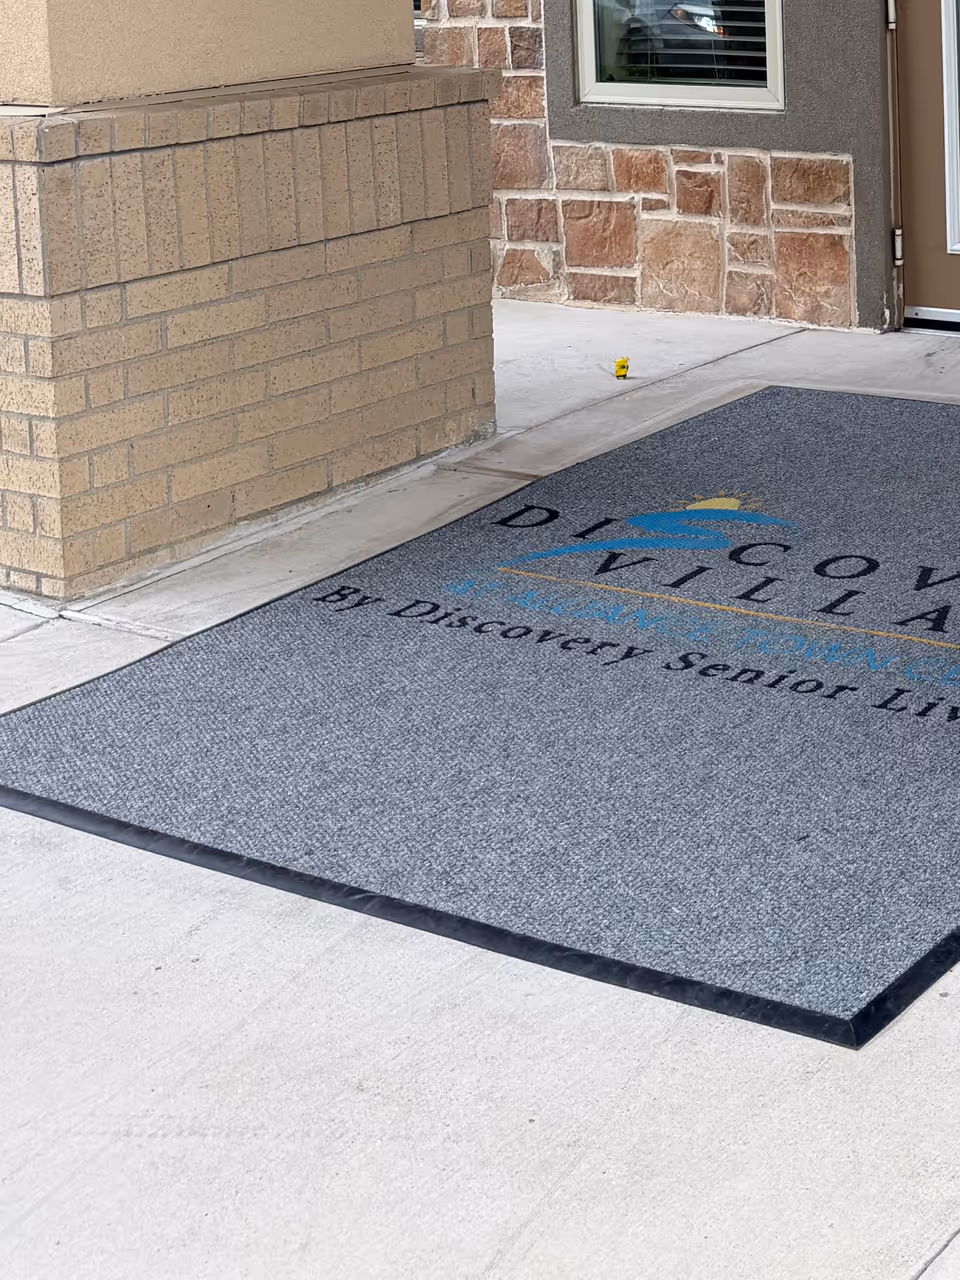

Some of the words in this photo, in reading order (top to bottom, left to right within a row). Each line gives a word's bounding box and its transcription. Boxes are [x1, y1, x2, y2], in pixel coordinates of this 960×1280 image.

[313, 585, 384, 612] By
[388, 599, 654, 665] Discovery
[663, 651, 858, 699] Senior
[505, 589, 721, 642] ALLIANCE
[734, 628, 897, 671] TOWN
